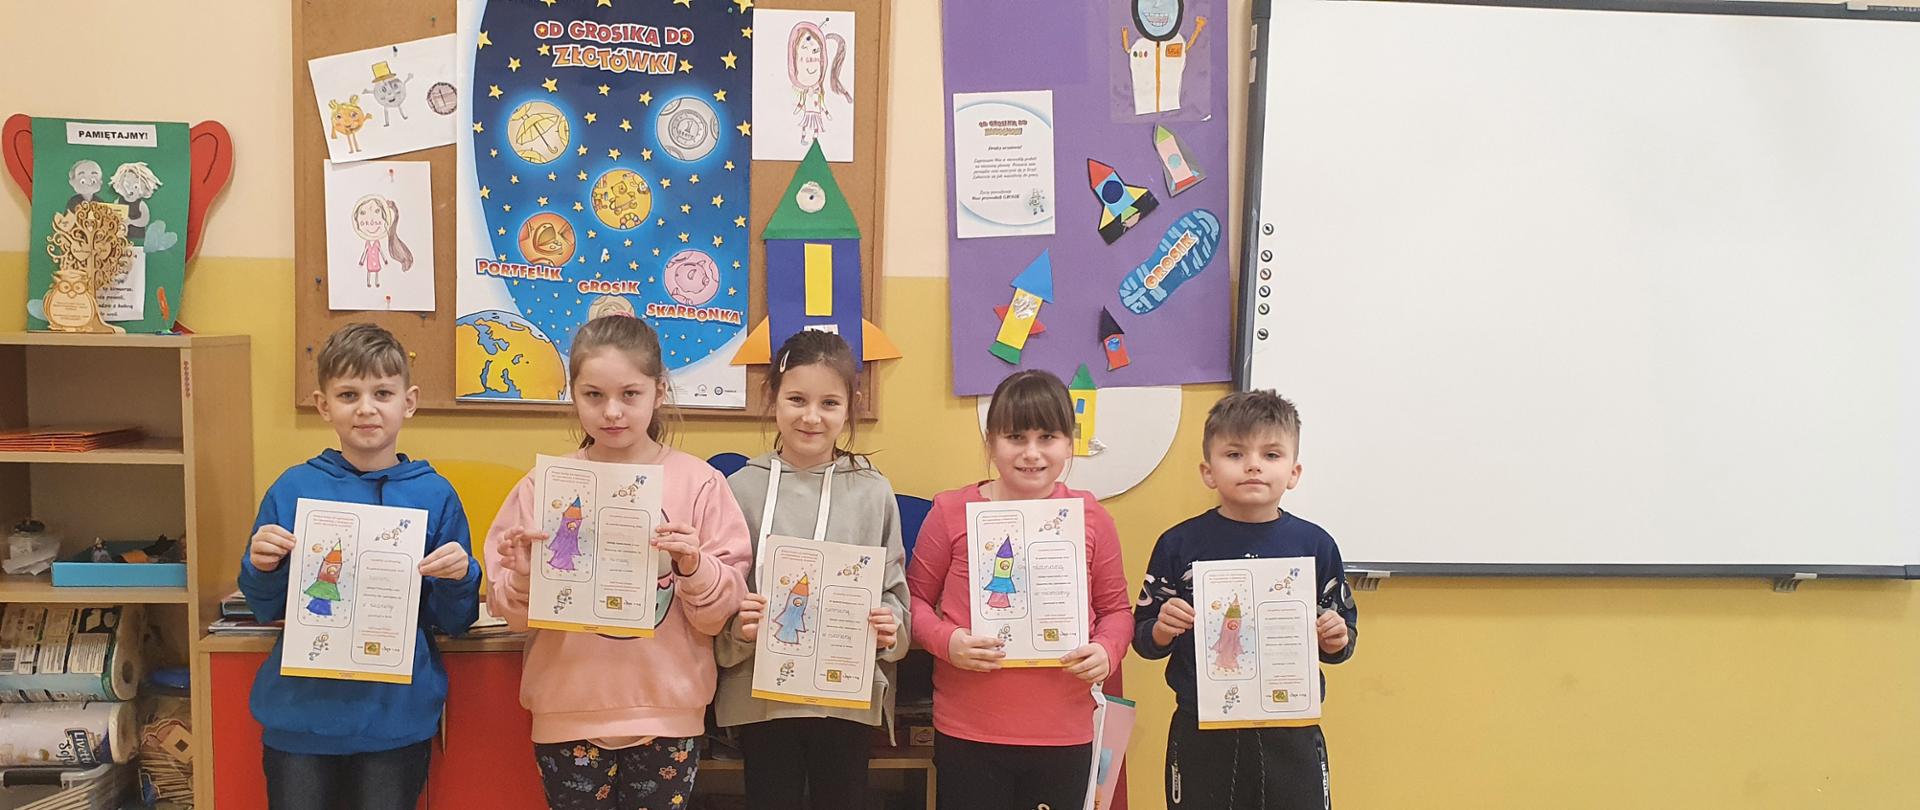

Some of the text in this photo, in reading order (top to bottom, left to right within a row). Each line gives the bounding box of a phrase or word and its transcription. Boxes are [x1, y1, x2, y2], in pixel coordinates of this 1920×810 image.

[535, 22, 694, 46] OD GROSIKA DO
[553, 46, 677, 74] ZŁOTÓWKI
[78, 130, 148, 141] PAMIĘTAJMY!
[477, 260, 563, 280] PORTFELIK
[1144, 231, 1199, 289] GROSIK
[578, 281, 640, 295] GROSIK
[646, 304, 741, 324] SKARBONKA
